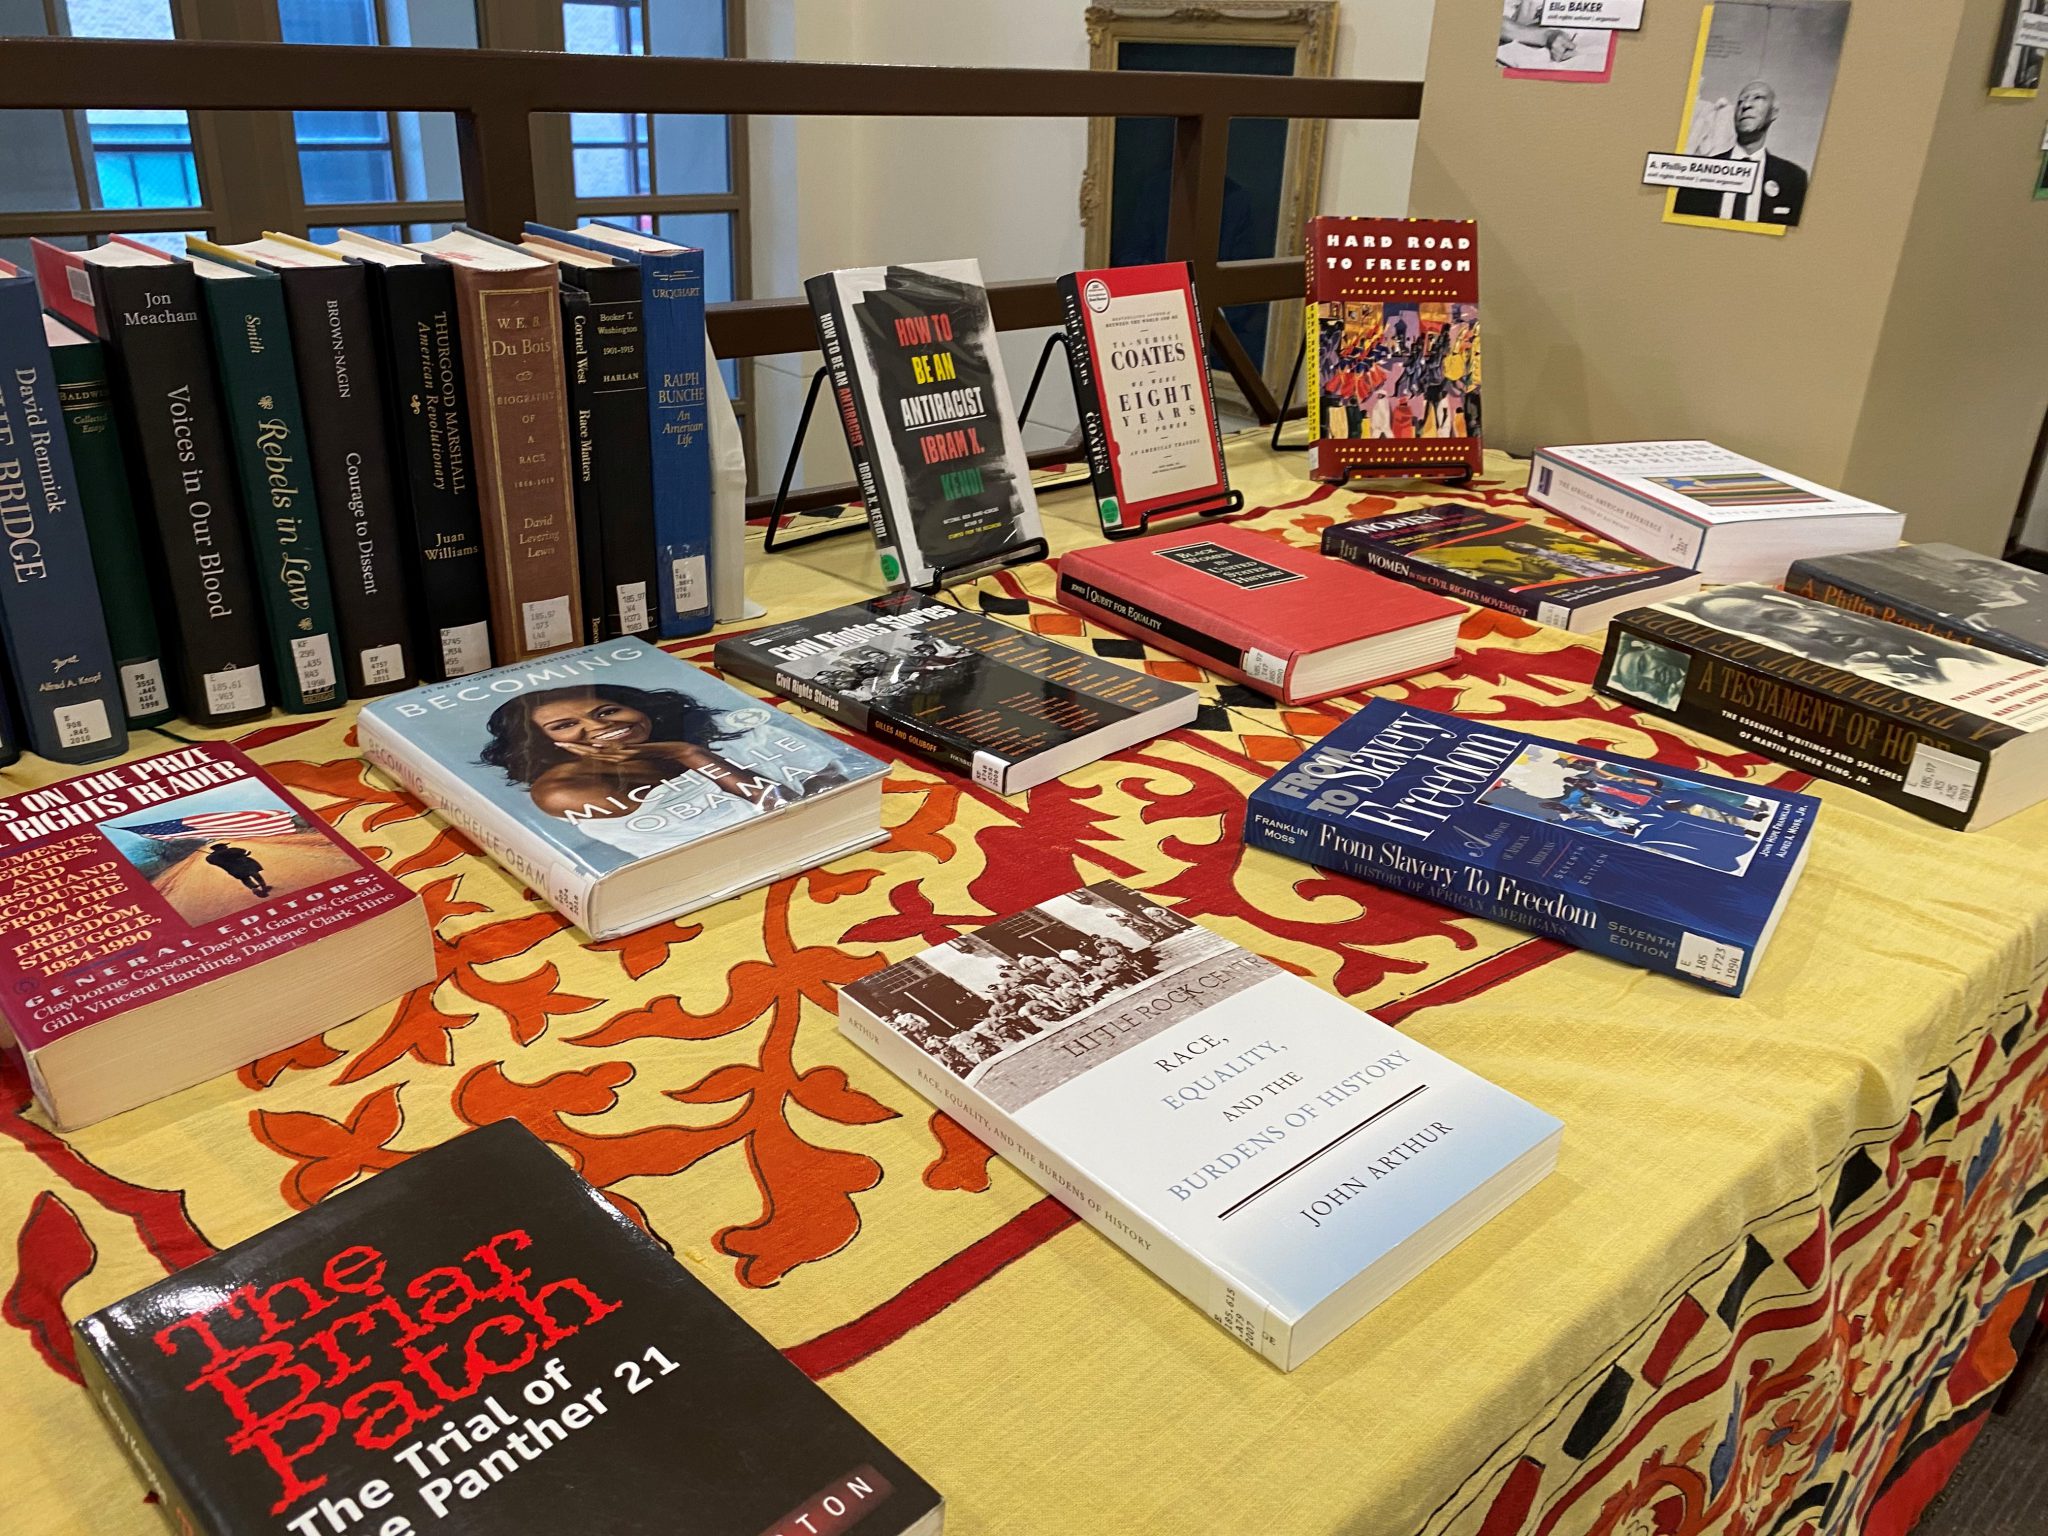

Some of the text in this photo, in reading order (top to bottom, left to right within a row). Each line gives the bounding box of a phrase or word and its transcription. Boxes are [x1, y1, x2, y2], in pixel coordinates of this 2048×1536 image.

[1568, 2, 1603, 12] BAKER
[1689, 163, 1752, 177] RANDOLPH
[1327, 234, 1471, 250] HARD ROAD
[1326, 257, 1471, 272] TO FREEDOM
[144, 292, 172, 309] Jon
[652, 287, 701, 299] URQUHART
[125, 310, 198, 326] Meacham
[244, 314, 265, 354] Smith
[600, 313, 626, 322] Booker
[820, 312, 836, 339] HOW
[894, 313, 953, 347] HOW TO
[326, 299, 351, 399] BROWN-NAGIN
[417, 321, 434, 389] American
[492, 338, 551, 357] Du Bois
[911, 352, 956, 385] BE AN
[1111, 342, 1186, 371] COATES
[574, 315, 591, 439] Cornel West Race
[603, 372, 639, 383] HARLAN
[658, 387, 705, 403] BUNCHE
[664, 372, 700, 387] RALPH
[1120, 383, 1193, 412] EIGHT
[434, 311, 466, 495] THURGOOD MARSHALL
[900, 387, 985, 427] ANTIRACIST
[1122, 404, 1196, 427] YEARS
[15, 367, 67, 514] David Remnick
[519, 455, 547, 465] RACE
[920, 427, 985, 465] IBRAM X.
[1085, 411, 1107, 475] COATES
[167, 384, 232, 620] Voices in Our Blood
[940, 467, 985, 500] KENDI
[0, 458, 47, 584] BRIDGE
[256, 418, 313, 611] Rebels in Law
[345, 452, 379, 596] Courage to Dissent
[1346, 513, 1444, 535] WOMEN
[425, 545, 478, 561] Williams
[436, 532, 465, 546] Juan
[1368, 552, 1410, 576] WOMEN
[1427, 576, 1449, 592] CIVIL
[1449, 583, 1479, 601] RIGHTS
[1480, 594, 1529, 618] MOVEMENT
[1090, 590, 1162, 631] QUEST FOR EQUALITY
[768, 638, 827, 662] Civil
[813, 621, 892, 649] Rights
[875, 604, 960, 630] Stories
[396, 645, 643, 719] BECOMING
[775, 672, 840, 712] Civil Rights Stories
[1698, 661, 1880, 750] A TESTAMENT OF
[875, 720, 894, 735] GILLES
[1721, 710, 1904, 782] THE ESSENTIAL WRITINGS AND SPEECHES
[1270, 711, 1457, 800] FROM Slavery
[1739, 731, 1872, 786] OF MARTIN LUTHER KING, JR.
[6, 793, 129, 843] RIGHTS
[127, 758, 248, 805] READER
[21, 787, 71, 814] ON
[67, 769, 133, 799] THE
[128, 746, 219, 781] PRIZE
[564, 735, 808, 826] MICHELLE
[626, 763, 816, 834] OBAMA
[1306, 733, 1523, 842] TO Freedom
[440, 796, 501, 852] MICHELLE
[1254, 814, 1309, 838] FRANKLIN
[1264, 828, 1296, 845] MOSS
[12, 865, 66, 891] AND
[73, 883, 129, 905] THE
[1319, 823, 1374, 862] From
[1378, 841, 1458, 888] Slavery
[1463, 865, 1490, 896] To
[1497, 875, 1599, 930] Freedom
[12, 904, 144, 958] FREEDOM
[25, 872, 377, 1009] GENERAL EDITORS:
[27, 901, 114, 938] BLACK
[1607, 920, 1678, 949] SEVENTH
[19, 914, 162, 971] STRUGGLE,
[33, 883, 385, 1021] Clayborne Carson, David Garrow, Gerald
[42, 930, 153, 978] 1954-1990
[42, 892, 396, 1034] Gill, Vincent Harding, Darlene Clark Hine
[1609, 934, 1671, 960] EDITION
[1680, 959, 1692, 967] E
[1696, 953, 1709, 970] 185
[1711, 946, 1727, 975] .F723
[1726, 956, 1741, 980] 1994
[1061, 955, 1270, 1057] LITTLE ROCK CENTR
[1153, 1034, 1230, 1073] RACE,
[1161, 1040, 1289, 1111] EQUALITY,
[1221, 1071, 1303, 1122] AND THE
[848, 1016, 1153, 1252] ARTHUR RACE, EQUALITY, AND THE BURDENS OF HISTORY
[1166, 1050, 1411, 1202] BURDENS OF HISTORY
[1299, 1121, 1453, 1228] JOHN ARTHUR
[153, 1243, 386, 1372] The
[1224, 1287, 1236, 1331] 185.615
[186, 1228, 533, 1449] Briar
[1245, 1320, 1256, 1347] 2007
[227, 1275, 624, 1518] Patch
[394, 1355, 569, 1476] Trial of
[418, 1342, 684, 1519] Panther 21
